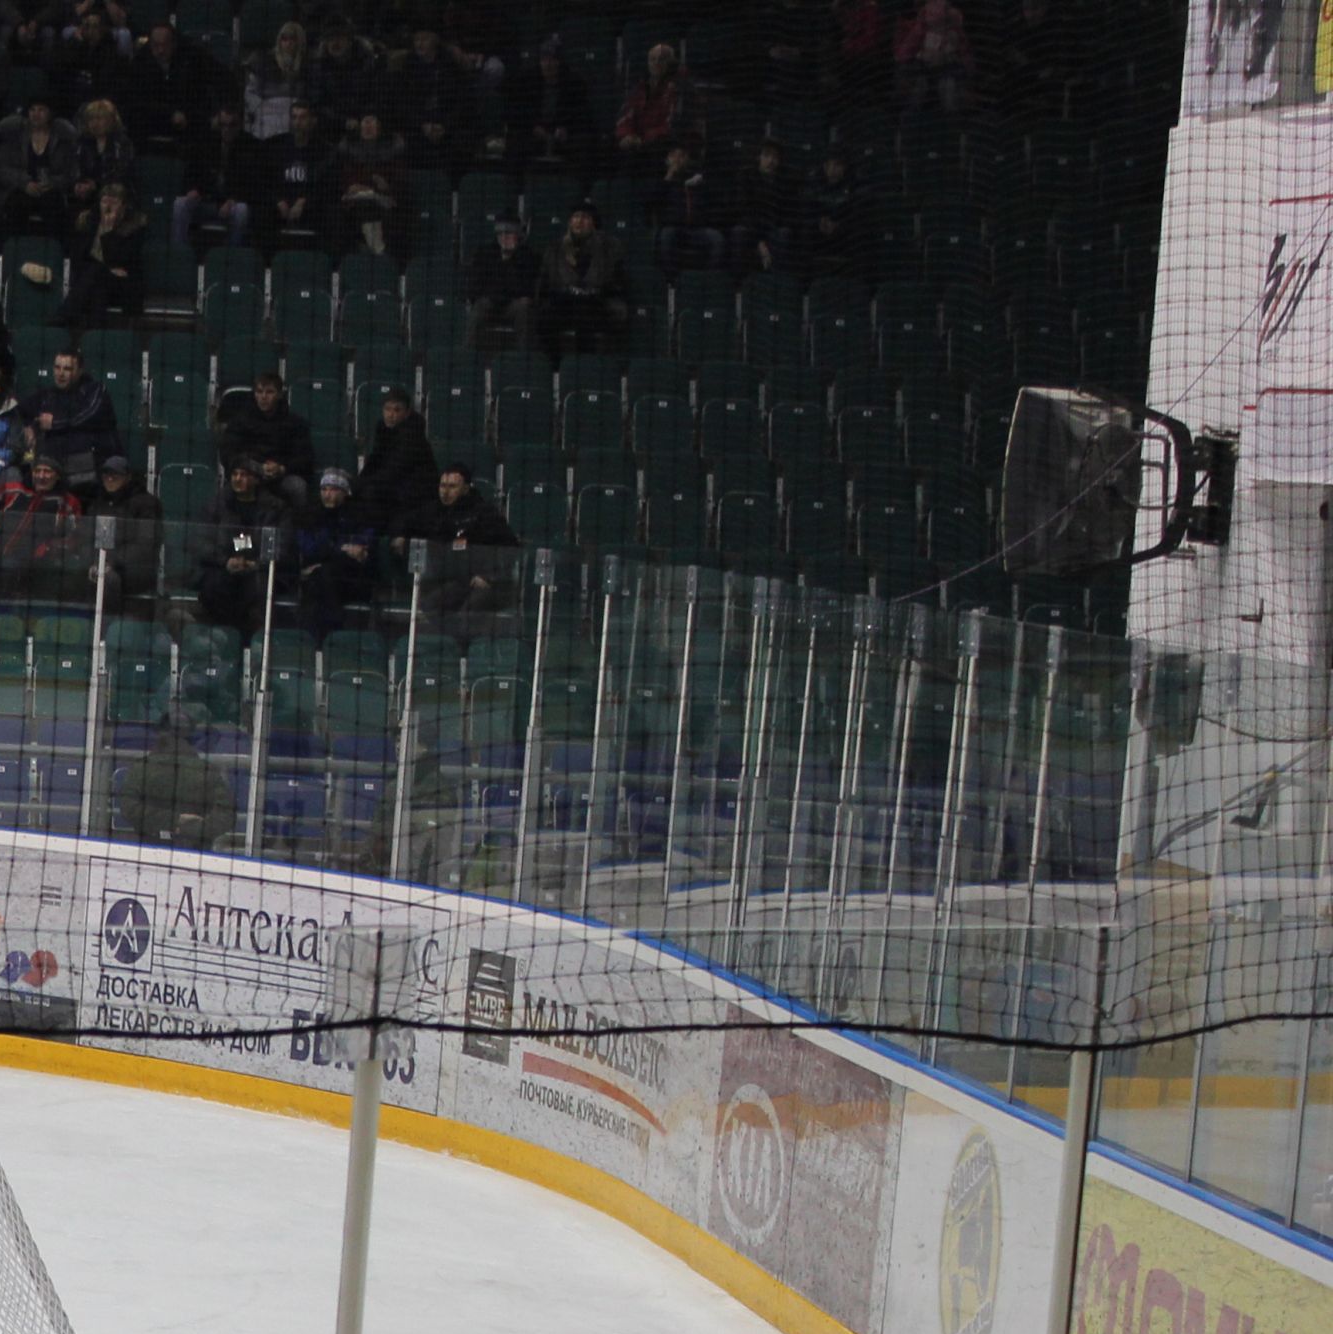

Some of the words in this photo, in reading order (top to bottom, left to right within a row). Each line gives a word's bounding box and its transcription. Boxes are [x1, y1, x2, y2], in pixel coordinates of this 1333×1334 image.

[169, 886, 322, 965] Аптека
[96, 974, 200, 1012] ДОСТАВКА
[94, 1004, 196, 1037] ЛЕКАРСТВ
[230, 1028, 272, 1056] ДОМ
